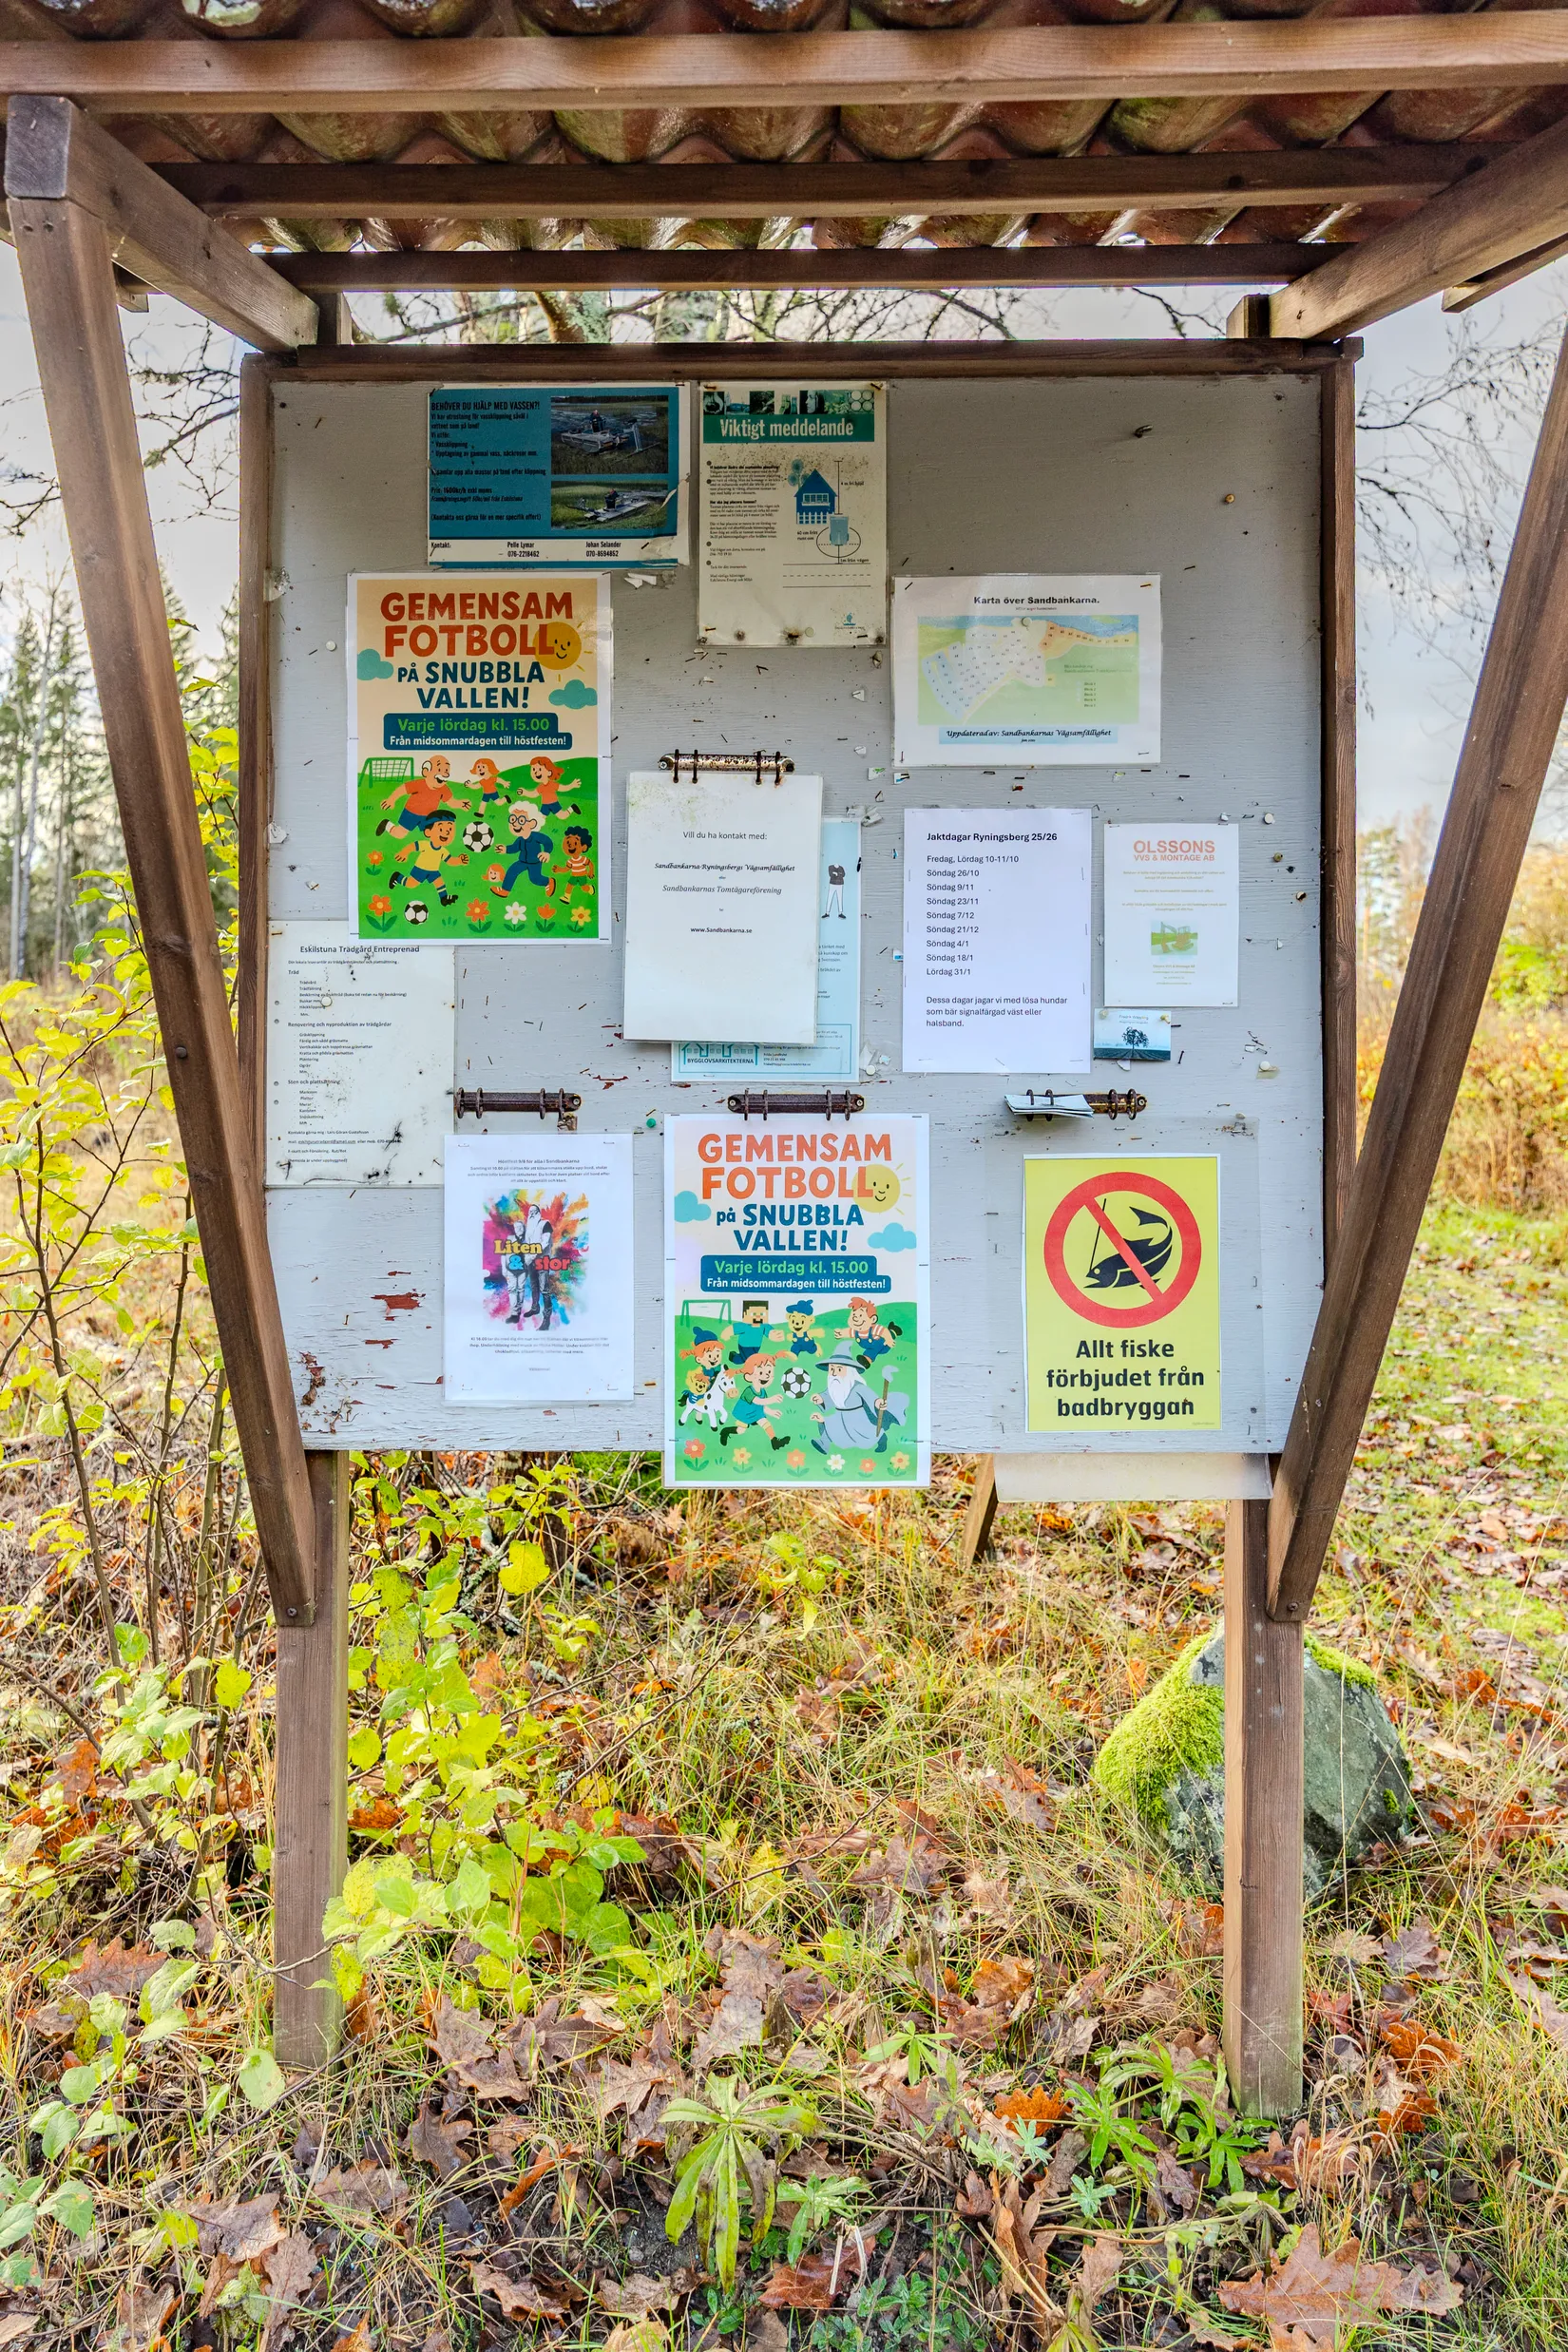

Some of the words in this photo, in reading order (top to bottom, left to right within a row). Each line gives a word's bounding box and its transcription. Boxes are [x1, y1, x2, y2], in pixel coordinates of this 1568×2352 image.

[431, 402, 460, 411] BEHÖVER
[462, 402, 471, 411] DU
[473, 400, 491, 411] HJÄLP
[494, 401, 507, 411] MED
[509, 401, 540, 411] VASSEN?!
[719, 419, 765, 440] Viktigt
[770, 418, 853, 436] meddelande
[380, 592, 573, 621] GEMENSAM
[385, 623, 555, 658] FOTBOLL
[397, 662, 418, 682] PÅ
[426, 661, 545, 683] SNUBBLA
[416, 687, 529, 709] VALLEN!
[397, 718, 434, 734] Varje
[440, 718, 487, 734] lördag
[491, 718, 507, 731] kl.
[513, 717, 549, 731] 15.00
[390, 736, 411, 745] Från
[413, 736, 496, 745] midsommardagen
[500, 736, 511, 745] till
[514, 736, 566, 745] höstfesten!
[927, 833, 970, 842] Jaktdagar
[973, 833, 1029, 842] Ryningsberg
[1133, 840, 1215, 853] OLSSONS
[927, 855, 955, 864] Fredag,
[927, 870, 956, 878] Söndag
[927, 926, 956, 934] Söndag
[340, 946, 372, 954] Trädgård
[927, 940, 956, 948] Söndag
[698, 1134, 891, 1162] GEMENSAM
[702, 1165, 873, 1200] FOTBOLL
[717, 1207, 736, 1226] på
[743, 1203, 864, 1226] SNUBBLA
[494, 1239, 542, 1255] Liten
[734, 1230, 848, 1251] VALLEN!
[509, 1255, 525, 1271] &
[534, 1255, 571, 1272] stor
[715, 1260, 753, 1275] Varje
[757, 1260, 804, 1275] lördag
[810, 1261, 826, 1273] kl.
[832, 1261, 869, 1273] 15.00
[707, 1277, 728, 1287] Från
[731, 1279, 815, 1288] midsommardagen
[818, 1279, 831, 1288] till
[832, 1279, 886, 1289] höstfesten!
[1076, 1340, 1113, 1358] Allt
[1121, 1340, 1175, 1357] fiske
[1047, 1369, 1151, 1391] förbjudet
[1158, 1367, 1204, 1386] från
[1057, 1399, 1194, 1420] badbryggan
